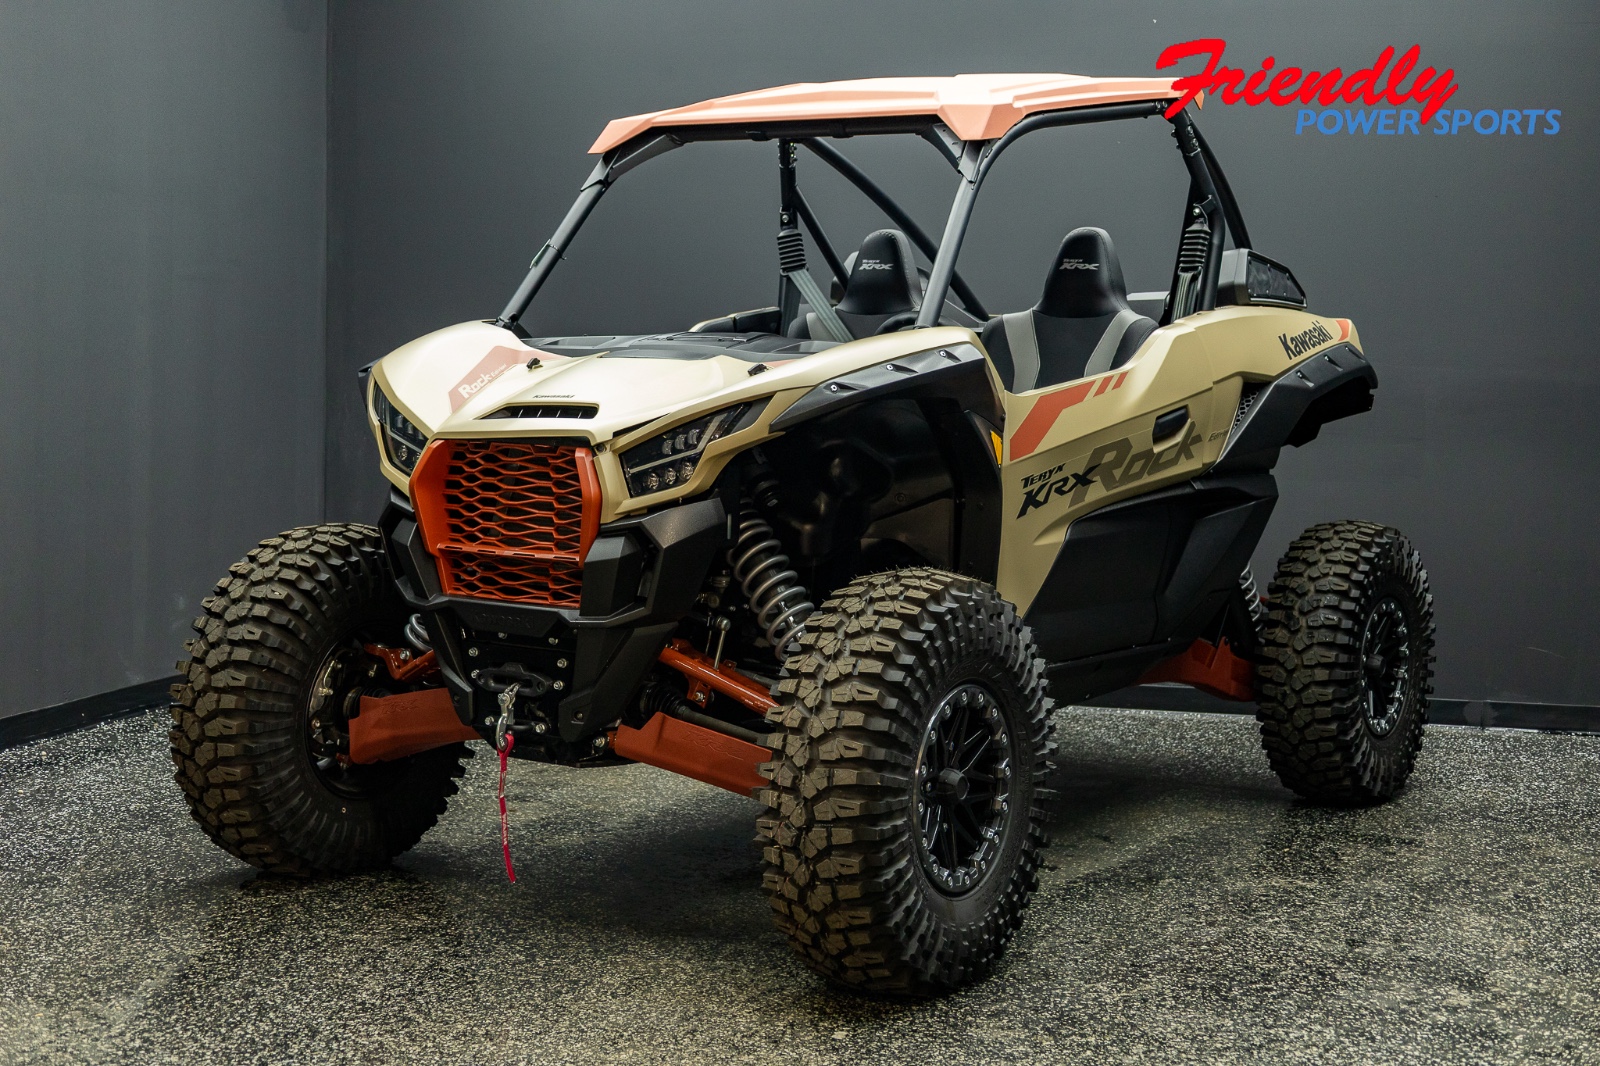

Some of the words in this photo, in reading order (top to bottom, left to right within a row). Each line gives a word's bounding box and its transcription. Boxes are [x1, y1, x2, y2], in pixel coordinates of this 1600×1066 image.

[858, 263, 894, 271] KRX
[1058, 263, 1100, 271] KRX
[1278, 320, 1334, 361] Kawasaki
[1016, 463, 1102, 520] KRX
